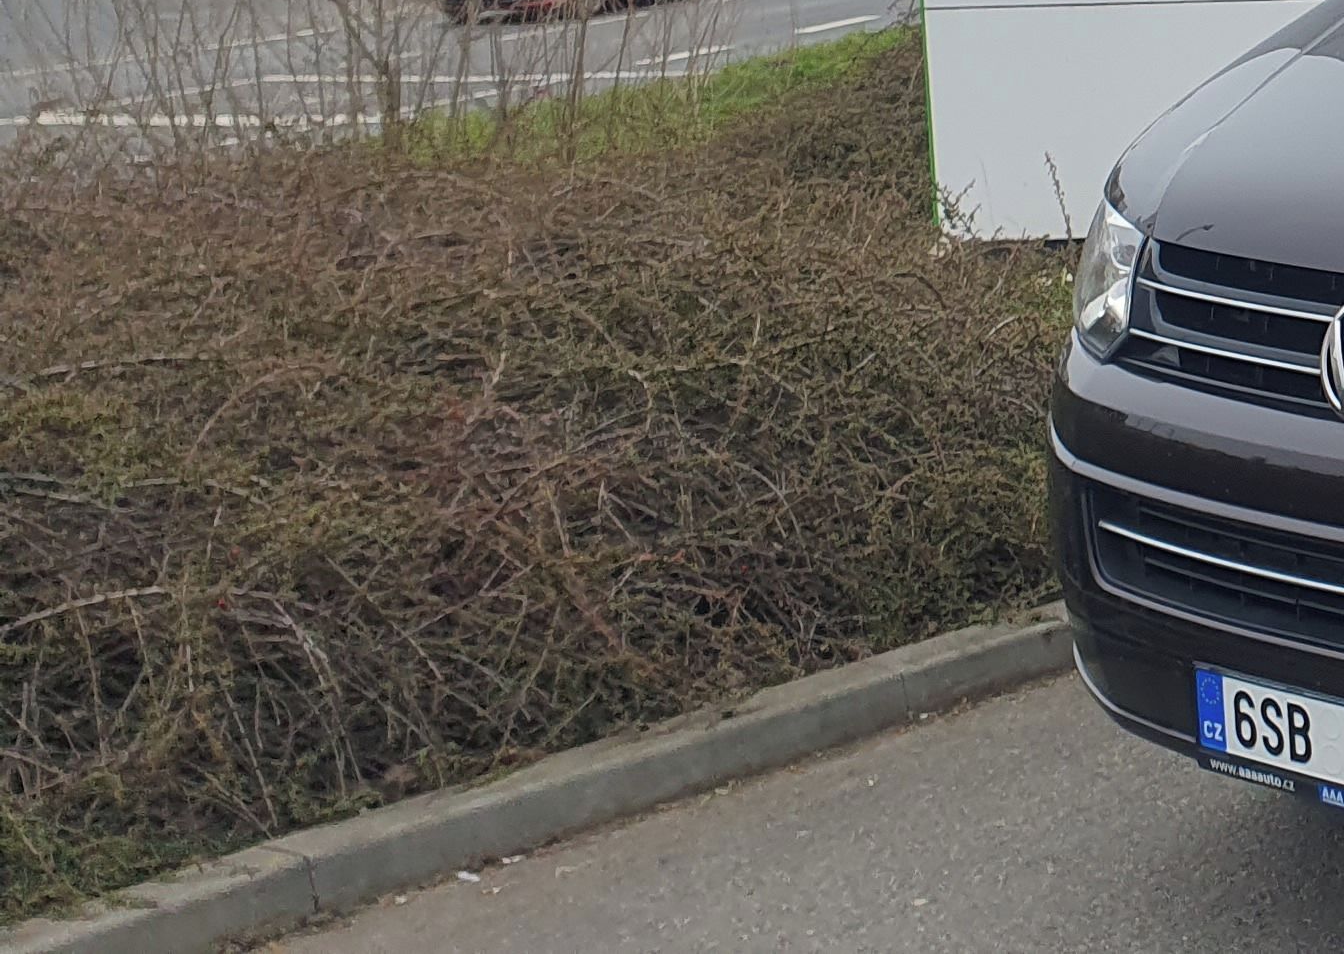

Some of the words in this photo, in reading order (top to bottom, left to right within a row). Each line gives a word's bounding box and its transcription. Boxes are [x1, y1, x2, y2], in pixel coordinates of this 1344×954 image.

[1203, 720, 1224, 741] CZ
[1233, 689, 1313, 764] 6SB
[1322, 787, 1344, 804] AAA
